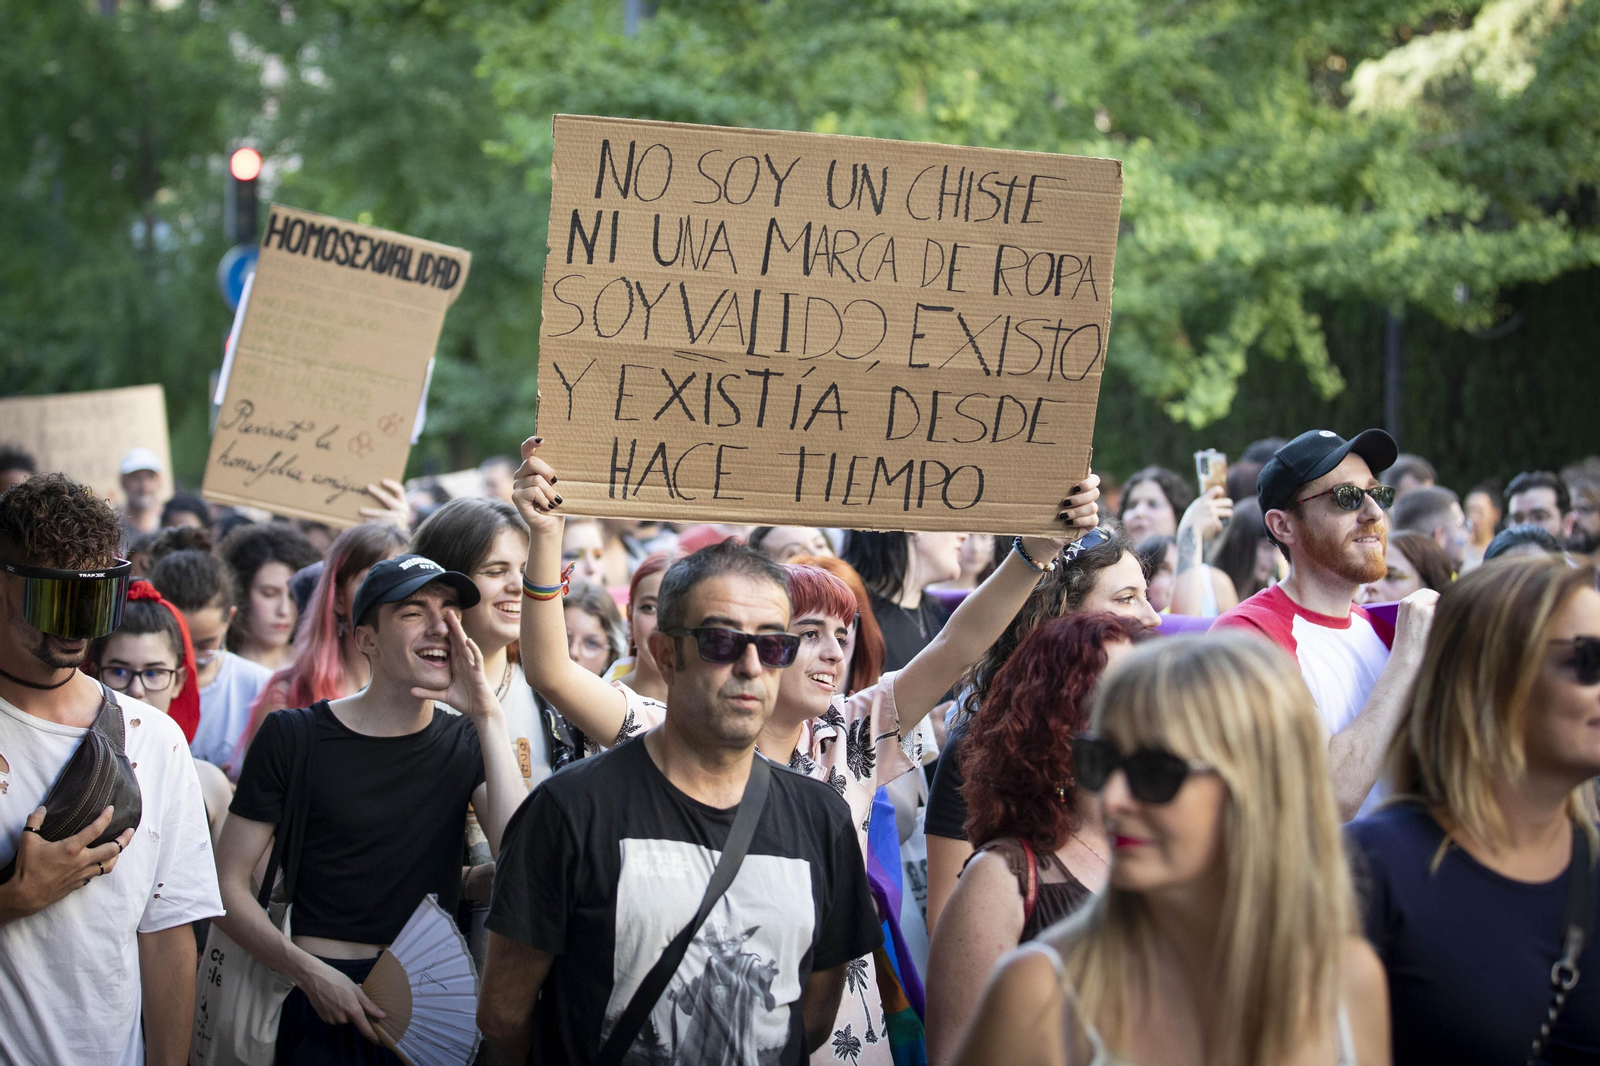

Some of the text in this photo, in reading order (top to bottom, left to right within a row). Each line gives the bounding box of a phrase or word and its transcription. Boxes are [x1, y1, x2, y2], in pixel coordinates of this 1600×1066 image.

[594, 139, 673, 202] NO
[693, 149, 801, 206] SOY
[827, 159, 888, 216] UN
[264, 213, 461, 290] HOMOSEXUALIDAD
[566, 209, 1099, 302] NI UNA MARCA DE ROPA
[548, 274, 672, 341] SOY
[910, 303, 1102, 382] EXISTO
[552, 358, 1066, 444] Y EXISTÍA DESDE
[609, 437, 984, 512] HACE TIEMPO
